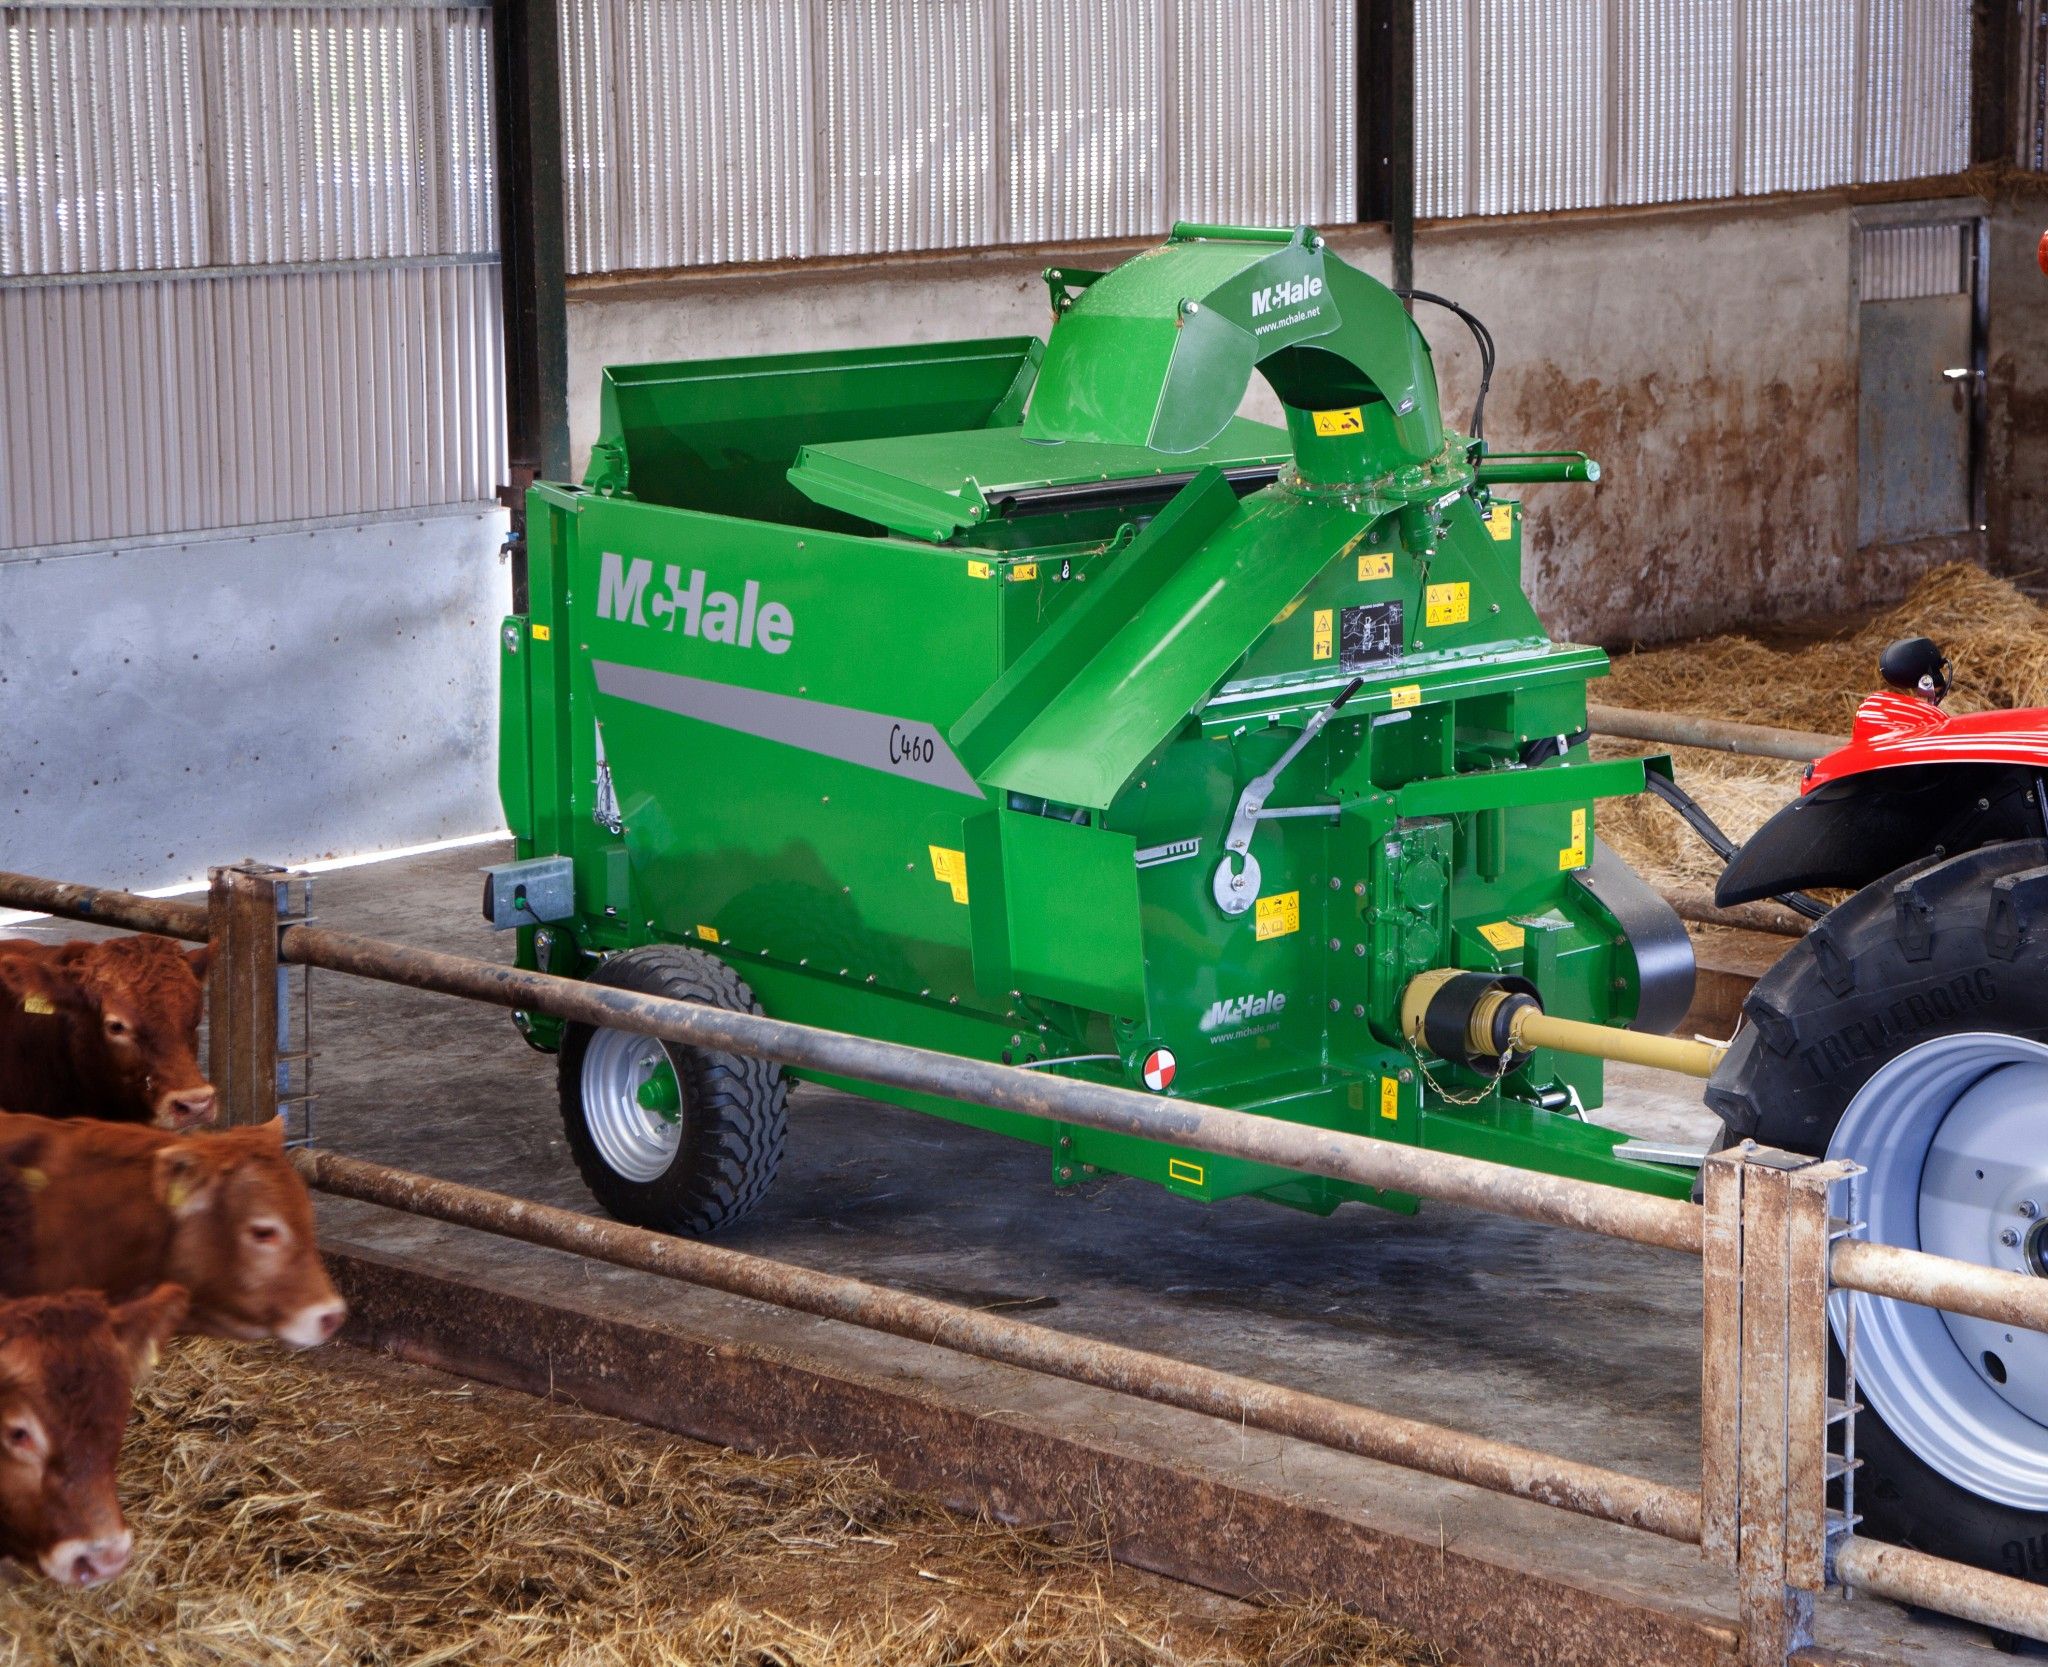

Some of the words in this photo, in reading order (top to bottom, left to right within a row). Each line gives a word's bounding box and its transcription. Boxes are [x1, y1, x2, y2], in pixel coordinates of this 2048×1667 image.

[1251, 274, 1323, 317] McHale
[1254, 305, 1321, 336] www.mchale.net
[596, 551, 794, 655] McHale
[889, 724, 934, 765] C460
[1210, 989, 1286, 1026] McHale
[1799, 966, 1997, 1083] TRELLEBORG
[1210, 1021, 1280, 1045] www.mchale.net
